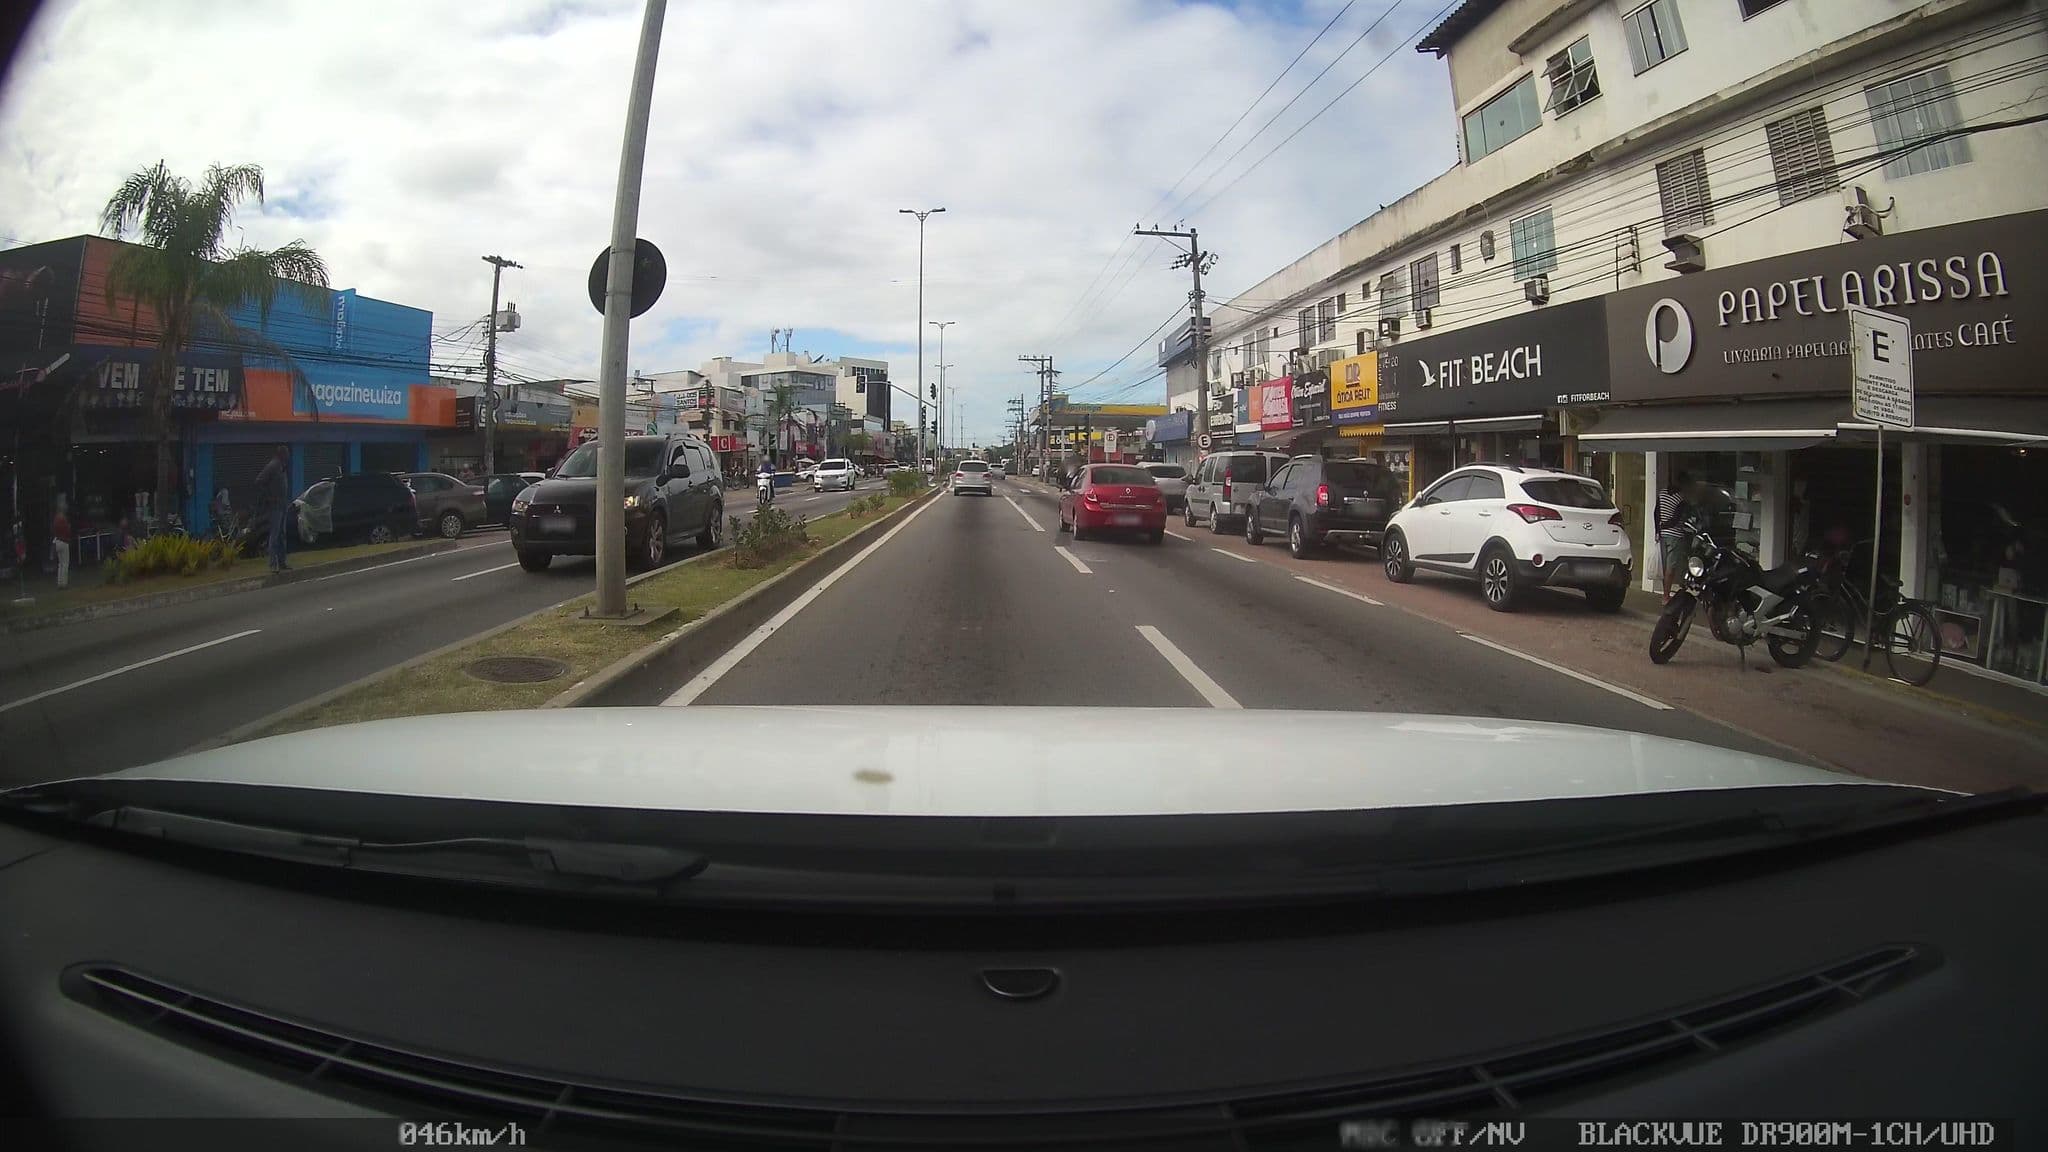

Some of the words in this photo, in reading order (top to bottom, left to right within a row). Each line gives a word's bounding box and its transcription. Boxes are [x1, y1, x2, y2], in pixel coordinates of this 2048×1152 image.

[1718, 251, 2009, 327] PAPELARISSA
[1723, 346, 1782, 364] LIVRARIA
[1958, 314, 2017, 346] CAFÉ
[1872, 330, 1890, 363] E
[98, 363, 139, 390] VEM
[193, 367, 229, 393] TEM
[1440, 359, 1463, 389] FIT
[1471, 344, 1542, 385] BEACH
[1570, 392, 1610, 402] FITFORBEACH
[1201, 436, 1209, 446] E
